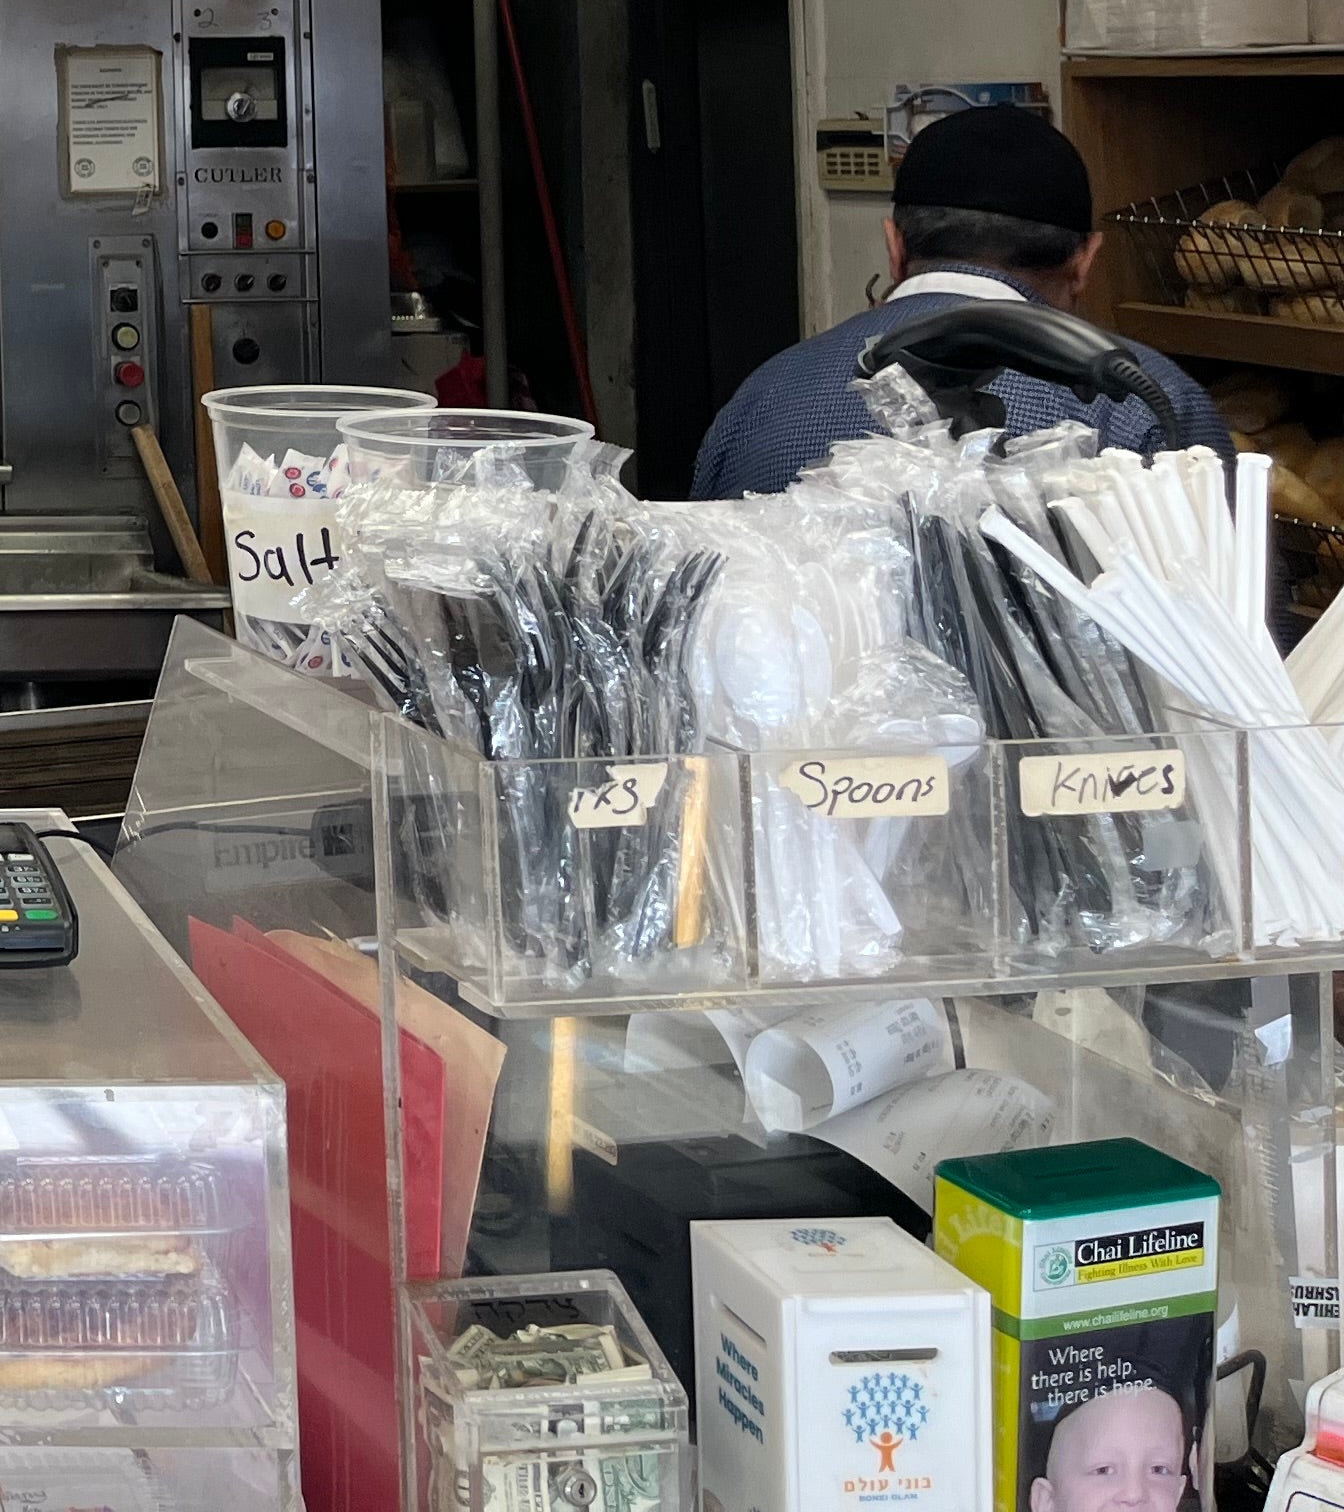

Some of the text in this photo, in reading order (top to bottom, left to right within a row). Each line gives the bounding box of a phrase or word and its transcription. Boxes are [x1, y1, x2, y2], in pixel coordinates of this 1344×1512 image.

[193, 165, 284, 185] CUTLER
[234, 528, 340, 587] Salt
[795, 762, 939, 813] Spoons
[1051, 760, 1176, 807] Knives
[1077, 1228, 1199, 1265] Chai Lifeline
[1077, 1254, 1198, 1281] Fighting Illness With Love
[1063, 1304, 1169, 1331] www.chailifeline.org
[720, 1331, 760, 1382] Where
[1048, 1345, 1104, 1366] Where
[715, 1356, 766, 1417] Miracles
[1030, 1369, 1075, 1390] there
[1078, 1364, 1092, 1383] is
[1047, 1376, 1158, 1407] there is hope.
[718, 1385, 765, 1445] Happen
[843, 1476, 933, 1494] בוני עולם
